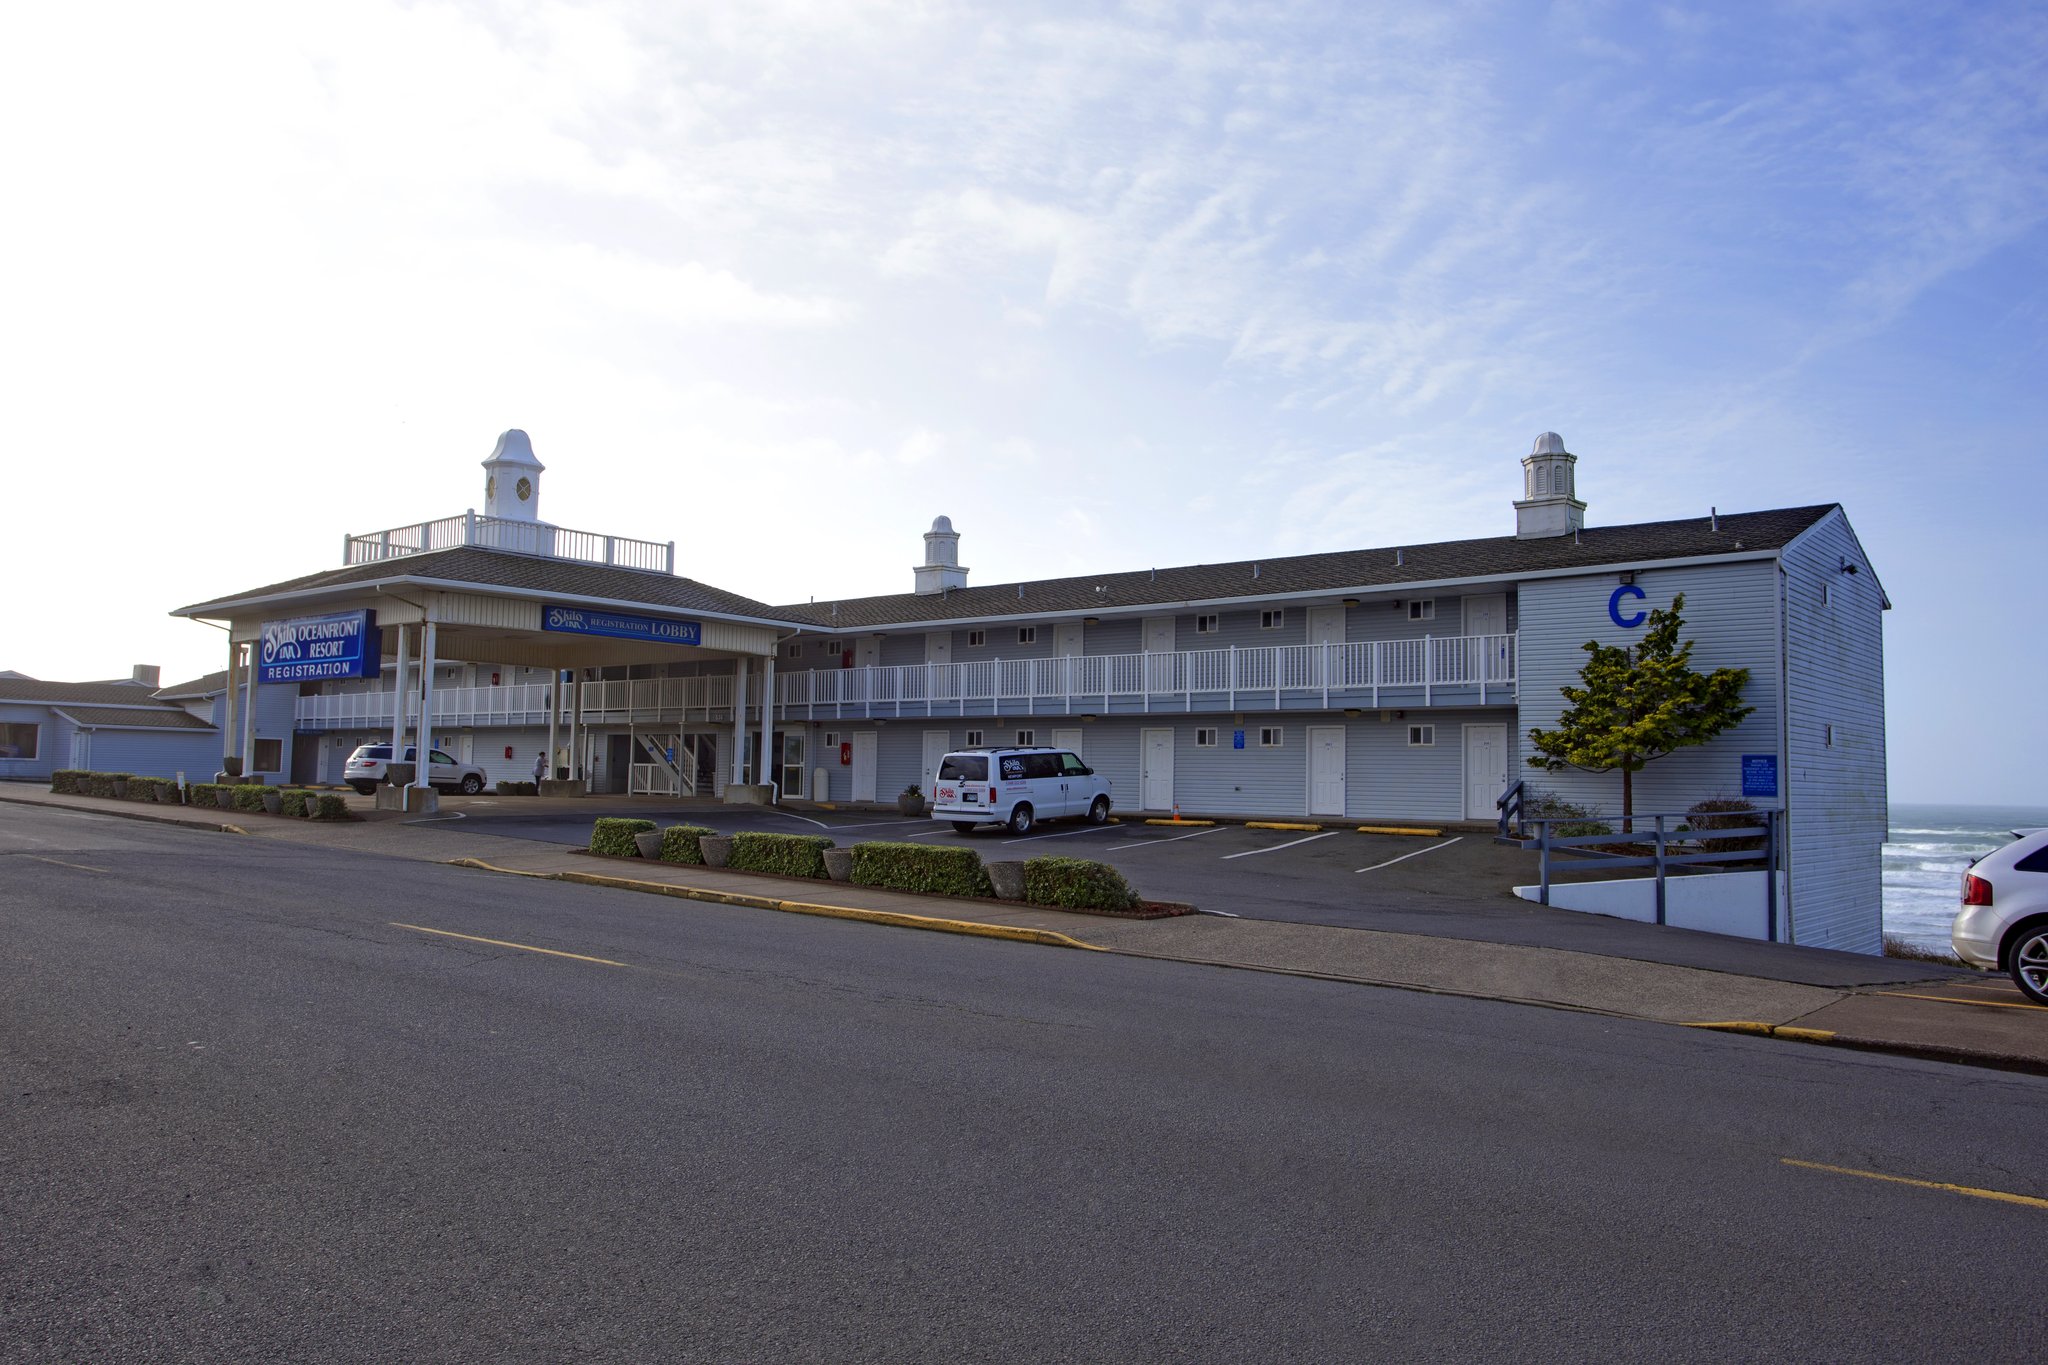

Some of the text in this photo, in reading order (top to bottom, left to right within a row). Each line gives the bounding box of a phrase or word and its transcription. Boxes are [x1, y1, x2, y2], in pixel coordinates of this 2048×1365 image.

[1608, 585, 1647, 628] C
[550, 609, 588, 630] Shilo
[590, 617, 697, 639] REGISTRATION LOBBY
[298, 620, 359, 641] OCEANFRONT
[264, 623, 300, 663] Shilo
[310, 641, 344, 658] RESORT
[268, 662, 350, 679] REGISTRATION
